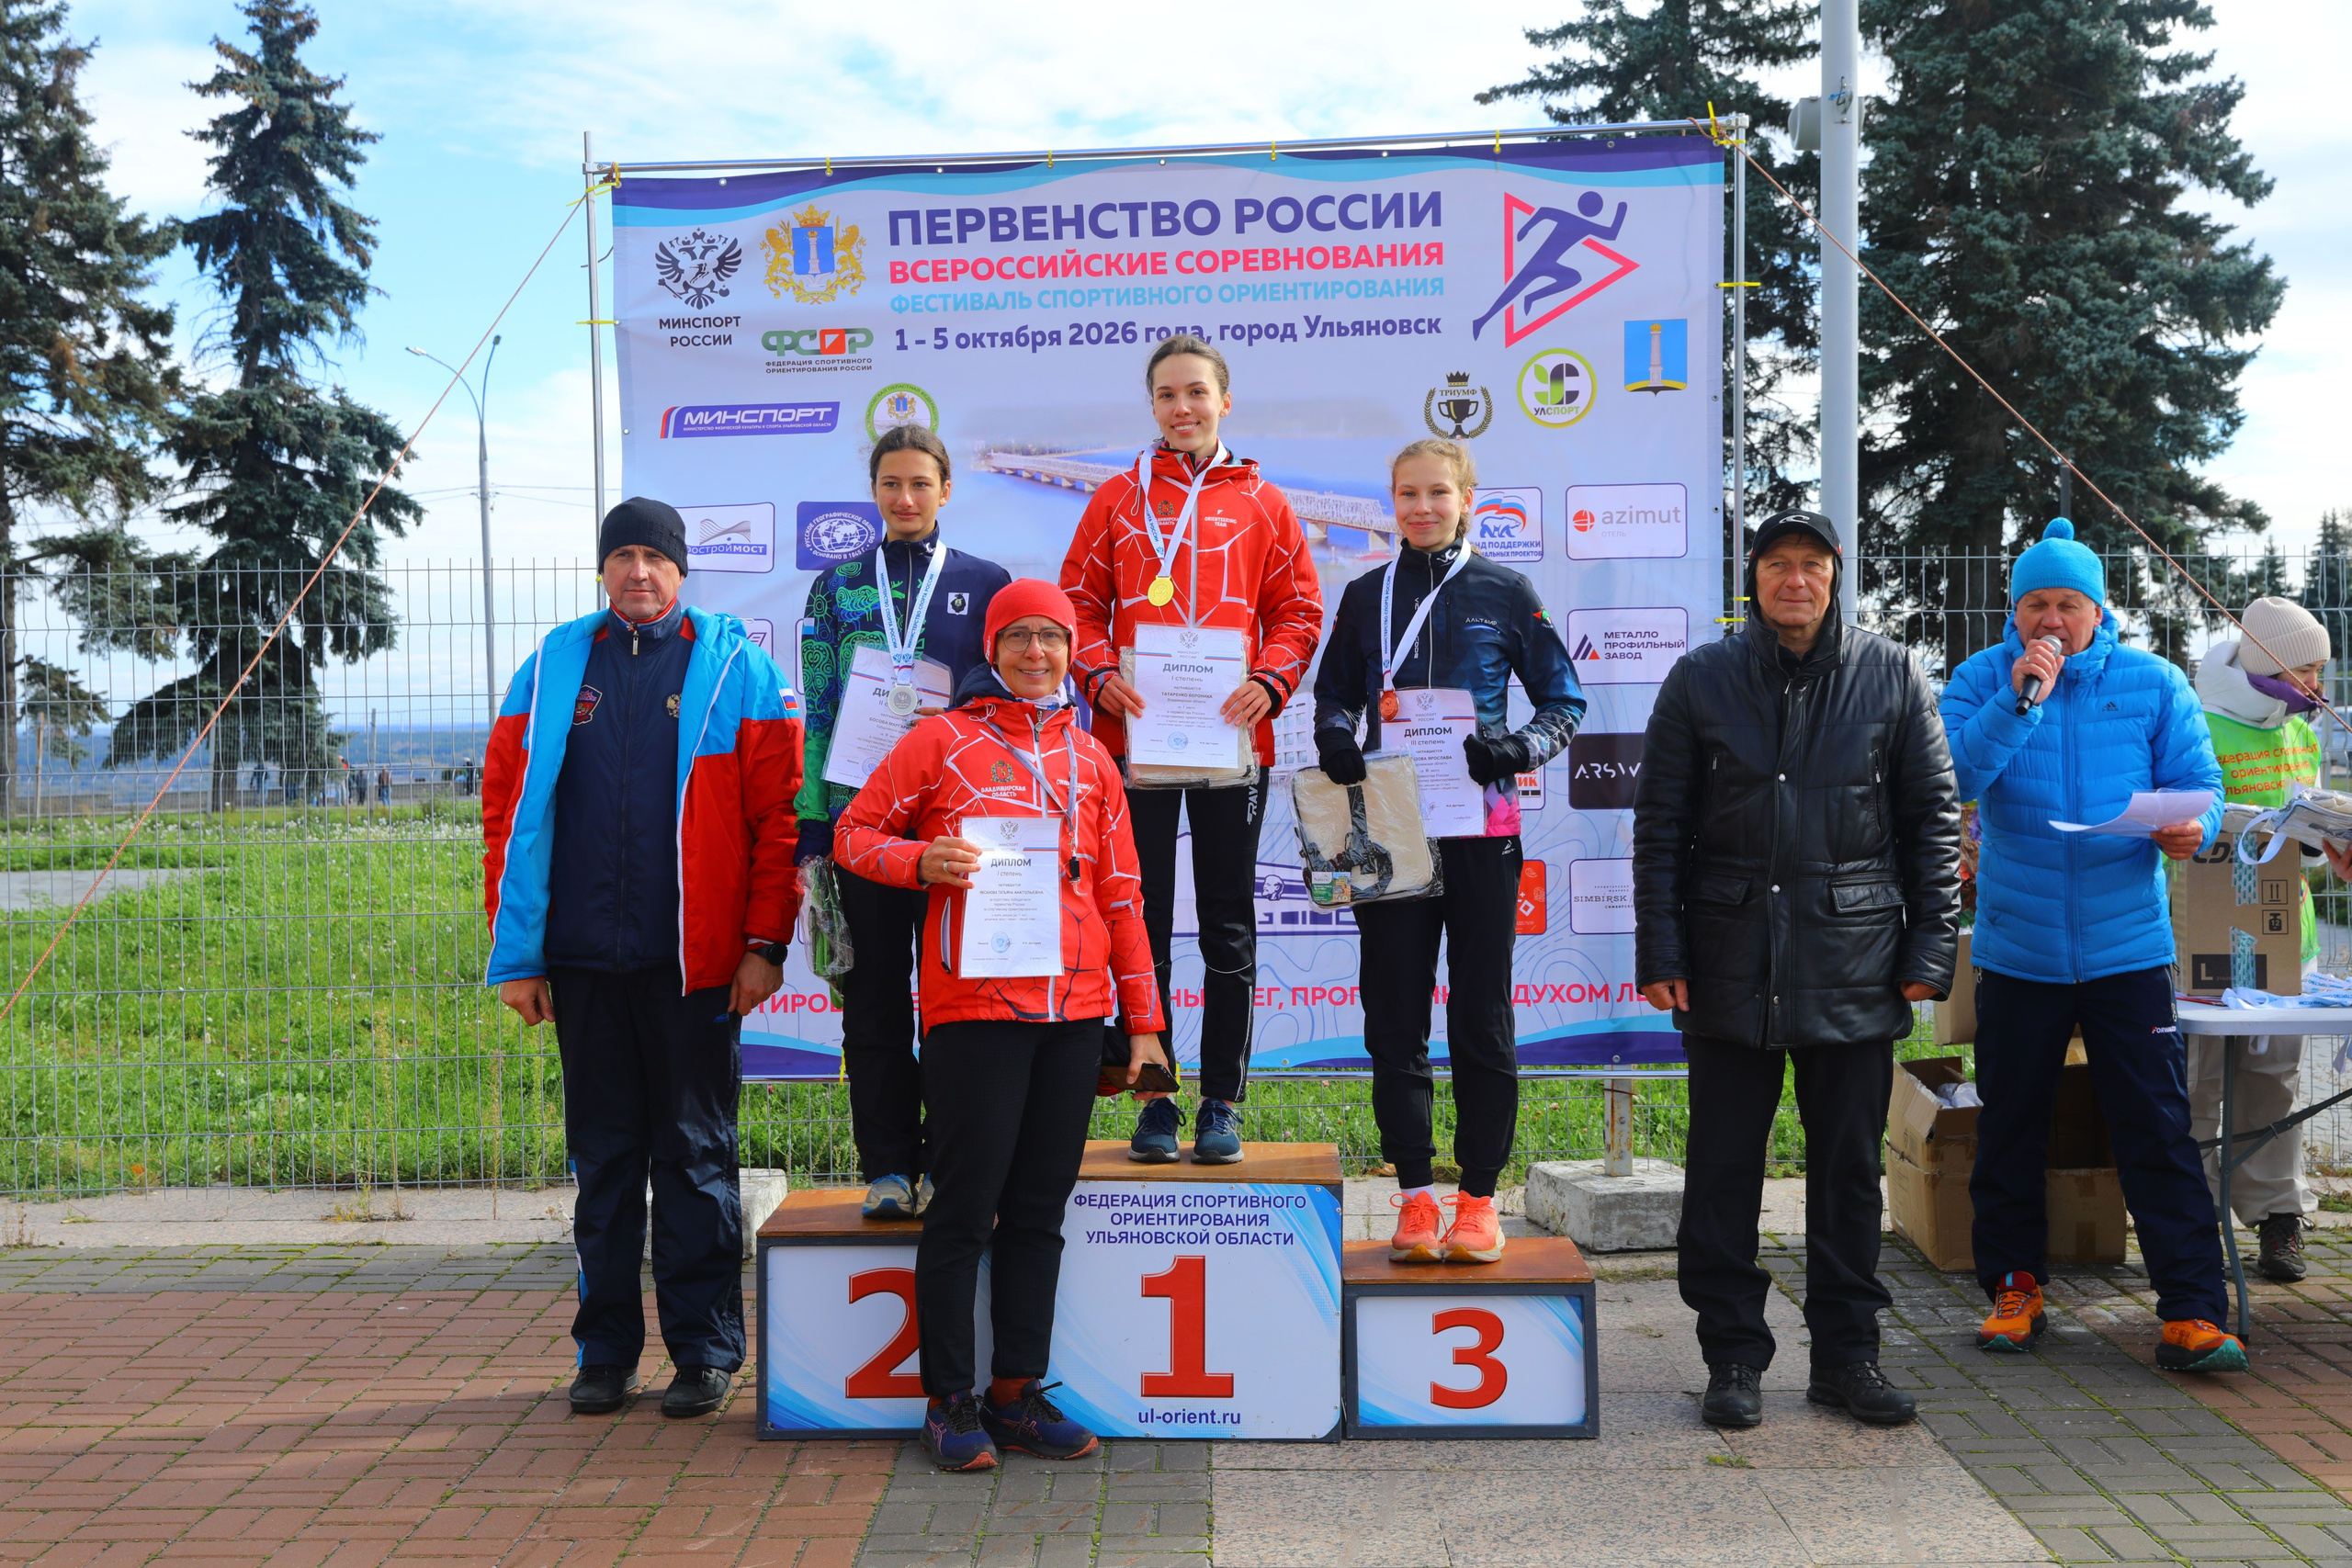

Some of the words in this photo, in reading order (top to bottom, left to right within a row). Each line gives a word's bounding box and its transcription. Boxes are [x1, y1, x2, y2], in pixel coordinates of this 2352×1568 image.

[888, 198, 1220, 246] ПЕРВЕНСТВО
[1235, 191, 1442, 234] РОССИИ
[889, 249, 1167, 284] ВСЕРОССИЙСКИЕ
[1175, 242, 1443, 275] СОРЕВНОВАНИЯ
[889, 291, 1033, 314] ФЕСТИВАЛЬ
[1037, 284, 1213, 310] СПОРТИВНОГО
[1218, 277, 1444, 308] ОРИЕНТИРОВАНИЯ
[659, 315, 741, 330] МИНСПОРТ
[670, 334, 732, 347] РОССИИ
[933, 328, 948, 350] 5
[956, 324, 1061, 353] октября
[1069, 321, 1137, 345] 2026
[1220, 322, 1297, 346] город
[1303, 315, 1442, 339] Ульяновск
[815, 357, 873, 366] СПОРТИВНОГО
[765, 366, 838, 374] ОРИЕНТИРОВАНИЯ
[1439, 389, 1477, 398] ТРИУМФ
[684, 407, 832, 425] МИНСПОРТ
[1533, 406, 1580, 416] УЛСПОРТ
[1204, 516, 1238, 525] ORIENTEERING
[1601, 505, 1681, 525] azimut
[1488, 540, 1541, 549] ПОДДЕРЖКИ
[1604, 631, 1659, 639] МЕТАЛЛО
[1604, 639, 1685, 649] ПРОФИЛЬНЫЙ
[1604, 652, 1643, 660] ЗАВОД
[1163, 663, 1214, 673] ДИПЛОМ
[1405, 727, 1452, 738] ДИПЛОМ
[980, 785, 1026, 794] ВЛАДИМИРСКАЯ
[990, 858, 1031, 868] ДИПЛОМ
[2200, 963, 2213, 981] L
[1511, 984, 1610, 1008] ДУХОМ
[1073, 1194, 1176, 1209] ФЕДЕРАЦИЯ
[1181, 1194, 1306, 1209] СПОРТИВНОГО
[1110, 1213, 1270, 1226] ОРИЕНТИРОВАНИЯ
[1085, 1228, 1210, 1244] УЛЬЯНОВСКОЙ
[1215, 1232, 1295, 1245] ОБЛАСТИ
[845, 1267, 928, 1398] 2
[1141, 1255, 1235, 1398] 1
[1430, 1306, 1508, 1409] 3
[1137, 1407, 1241, 1427] ul-orient.ru
